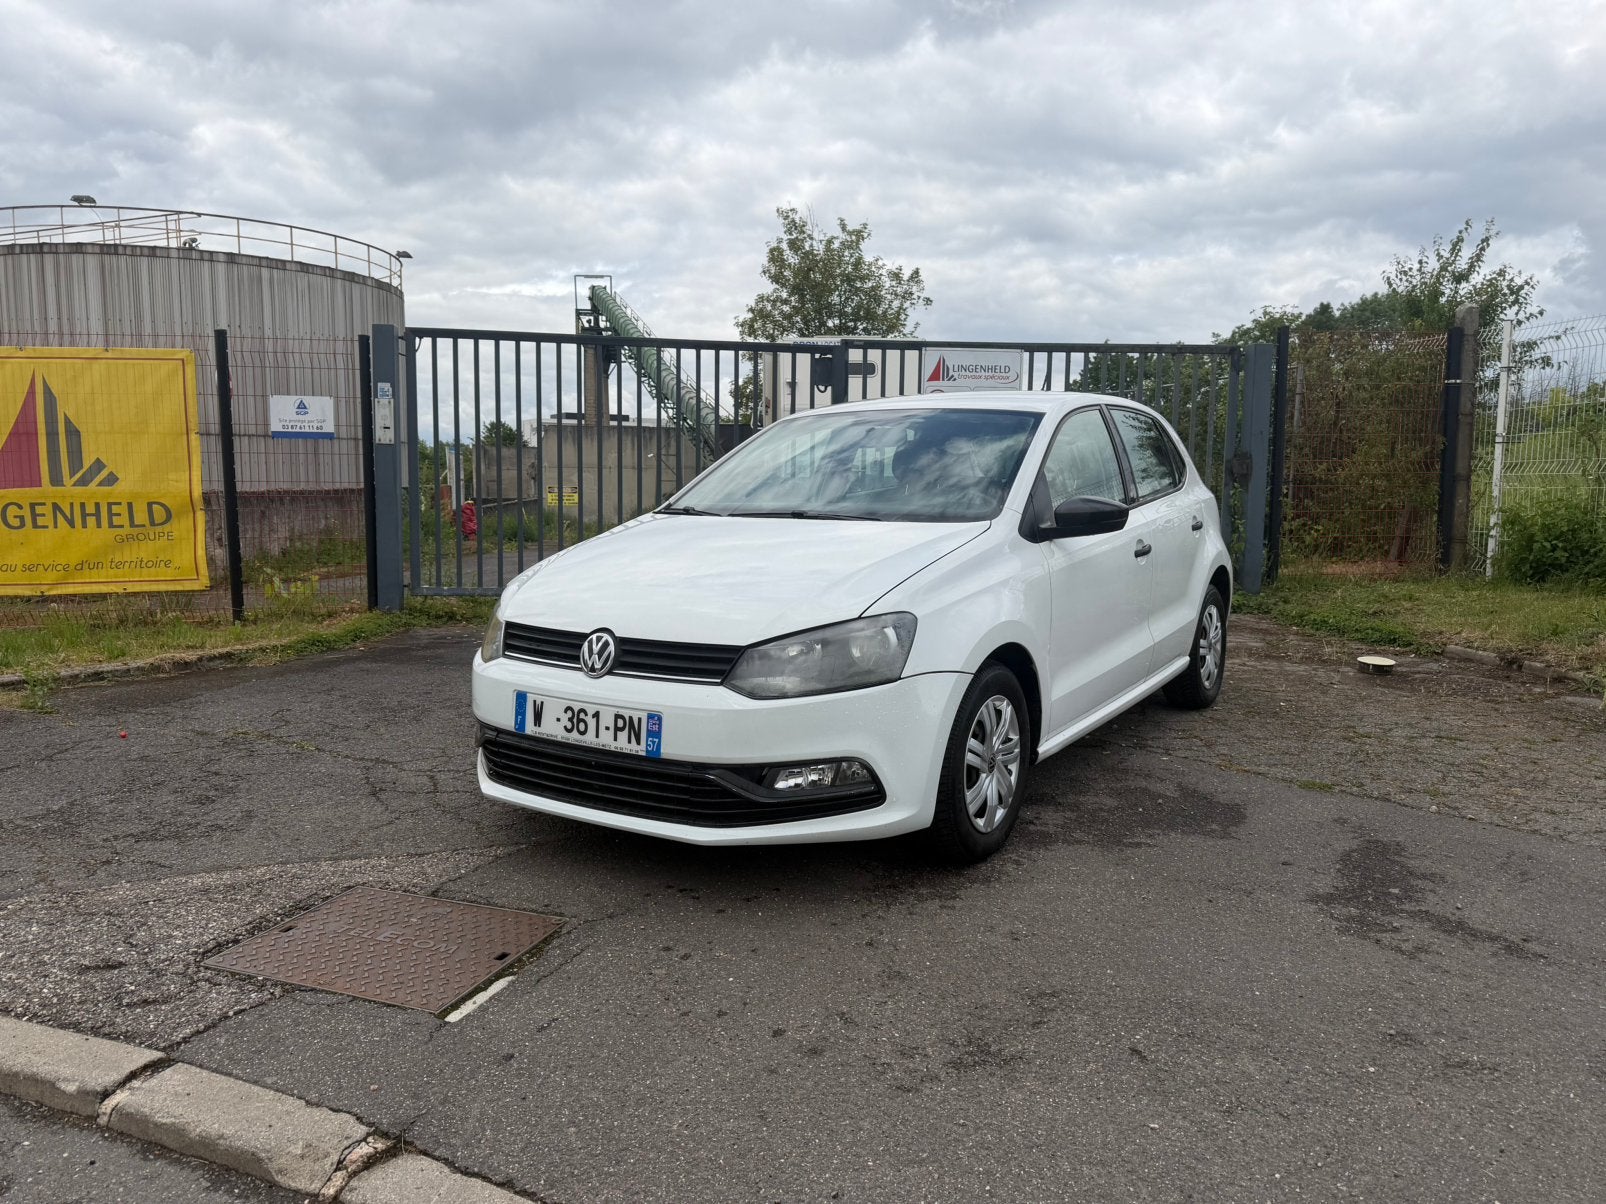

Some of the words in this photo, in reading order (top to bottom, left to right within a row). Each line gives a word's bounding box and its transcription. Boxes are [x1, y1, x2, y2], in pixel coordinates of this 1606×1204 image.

[952, 364, 1011, 374] LINGENHELD
[982, 373, 1011, 381] spéciaux
[0, 501, 173, 530] GENHELD
[114, 531, 175, 544] GROUPE
[0, 563, 17, 573] au
[21, 560, 70, 573] service
[74, 559, 104, 571] d'un
[647, 737, 659, 751] 57
[336, 925, 460, 954] TELECOM
